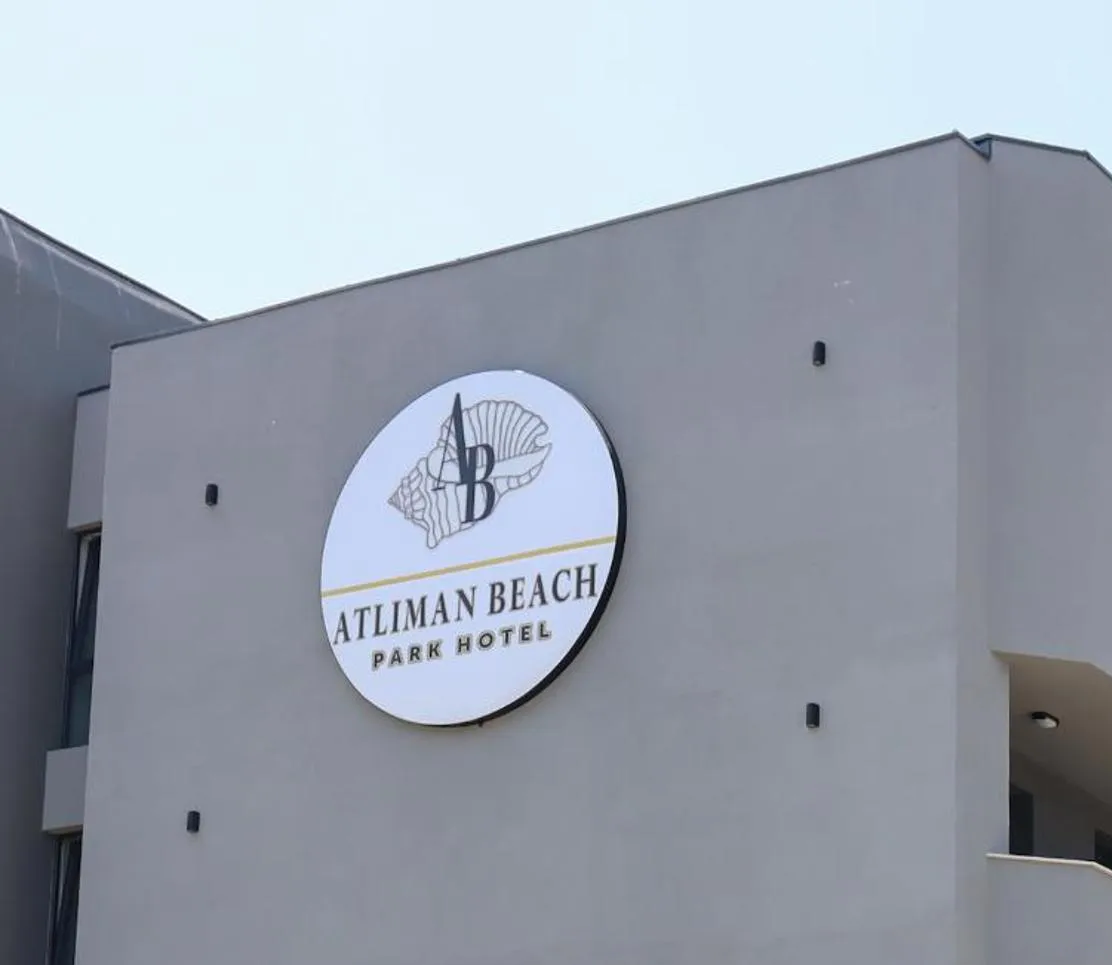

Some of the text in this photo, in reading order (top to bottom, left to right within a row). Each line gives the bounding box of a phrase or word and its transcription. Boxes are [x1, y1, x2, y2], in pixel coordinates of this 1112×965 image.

[333, 562, 599, 645] ATLIMAN BEACH
[372, 621, 553, 671] PARK HOTEL
